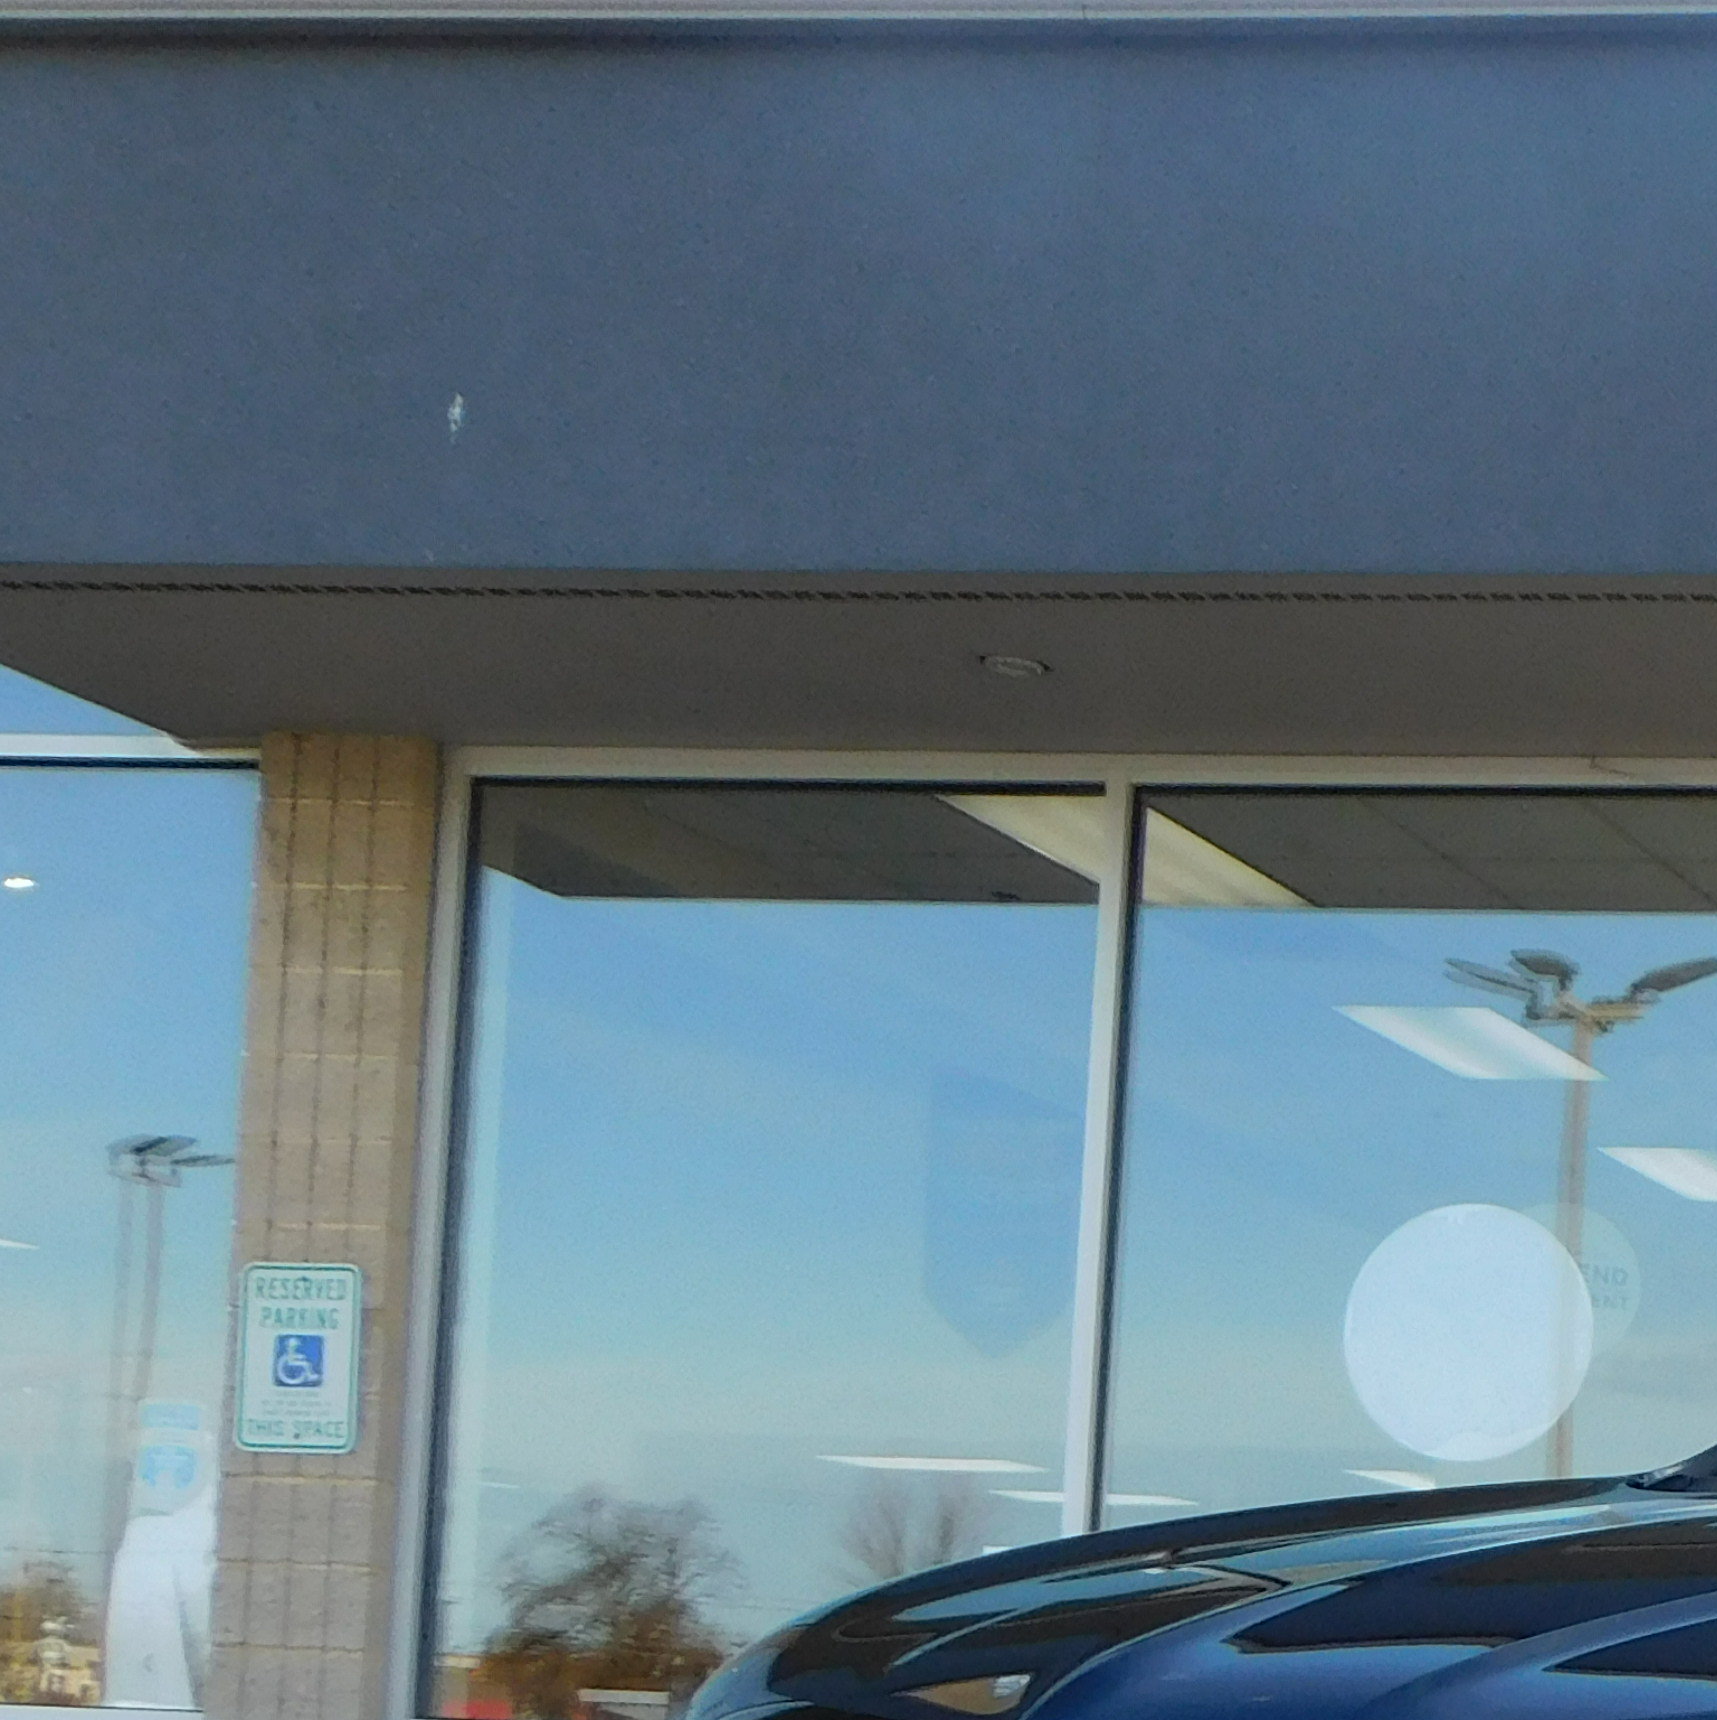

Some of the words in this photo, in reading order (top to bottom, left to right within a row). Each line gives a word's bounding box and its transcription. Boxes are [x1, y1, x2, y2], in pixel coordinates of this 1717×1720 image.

[255, 1276, 347, 1301] RESERVED
[260, 1306, 341, 1330] PARKING
[247, 1418, 285, 1436] THIS
[292, 1420, 346, 1439] SPACE
